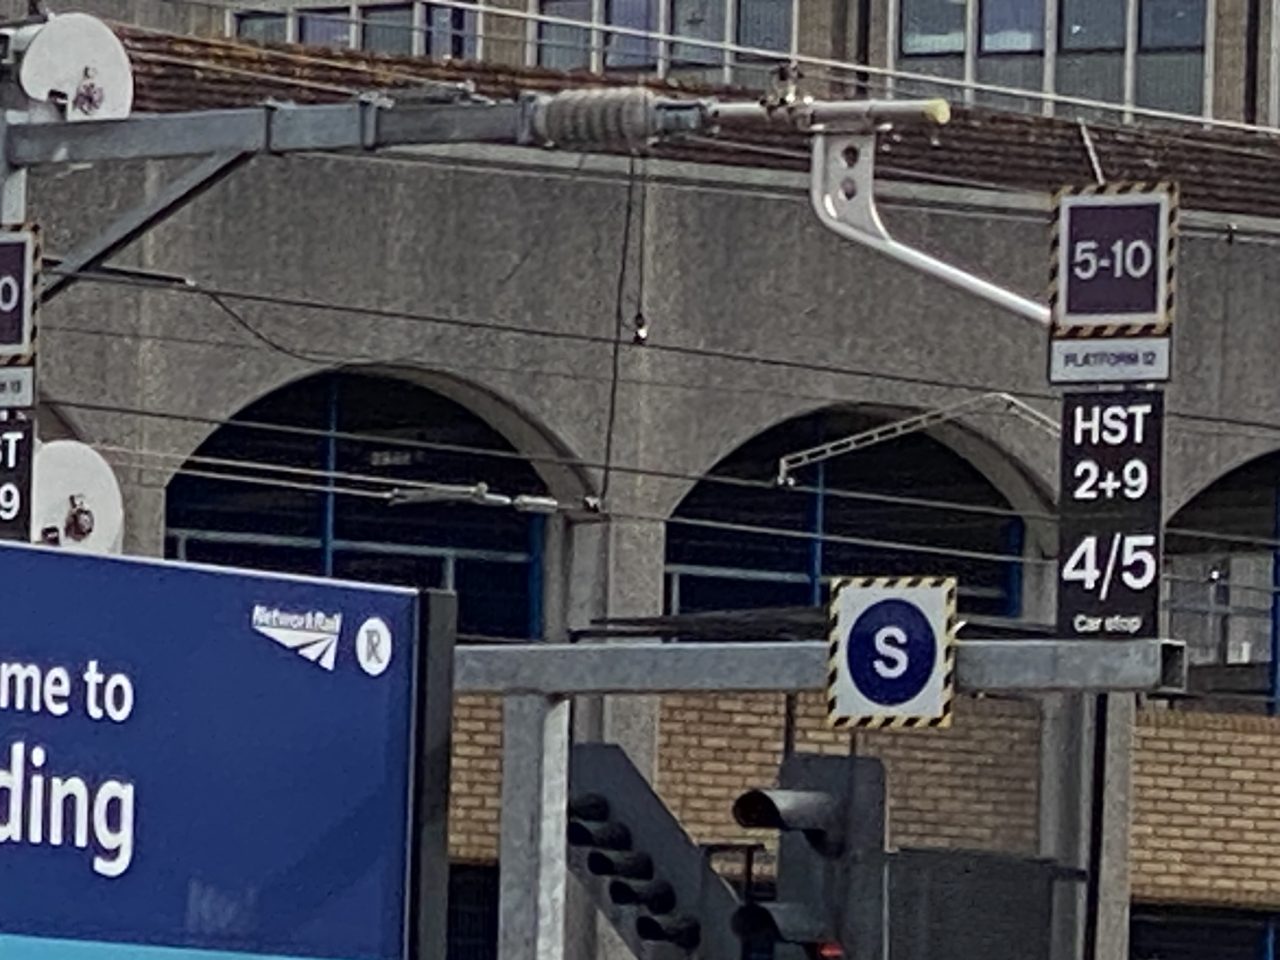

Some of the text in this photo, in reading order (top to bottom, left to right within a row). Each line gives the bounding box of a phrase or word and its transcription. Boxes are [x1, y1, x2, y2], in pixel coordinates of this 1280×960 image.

[1072, 239, 1152, 280] 5-10
[1073, 405, 1152, 446] HST
[1073, 459, 1149, 500] 2+9
[1062, 533, 1157, 600] 4/5
[1073, 614, 1101, 633] Car
[872, 625, 909, 680] S
[84, 660, 135, 722] to
